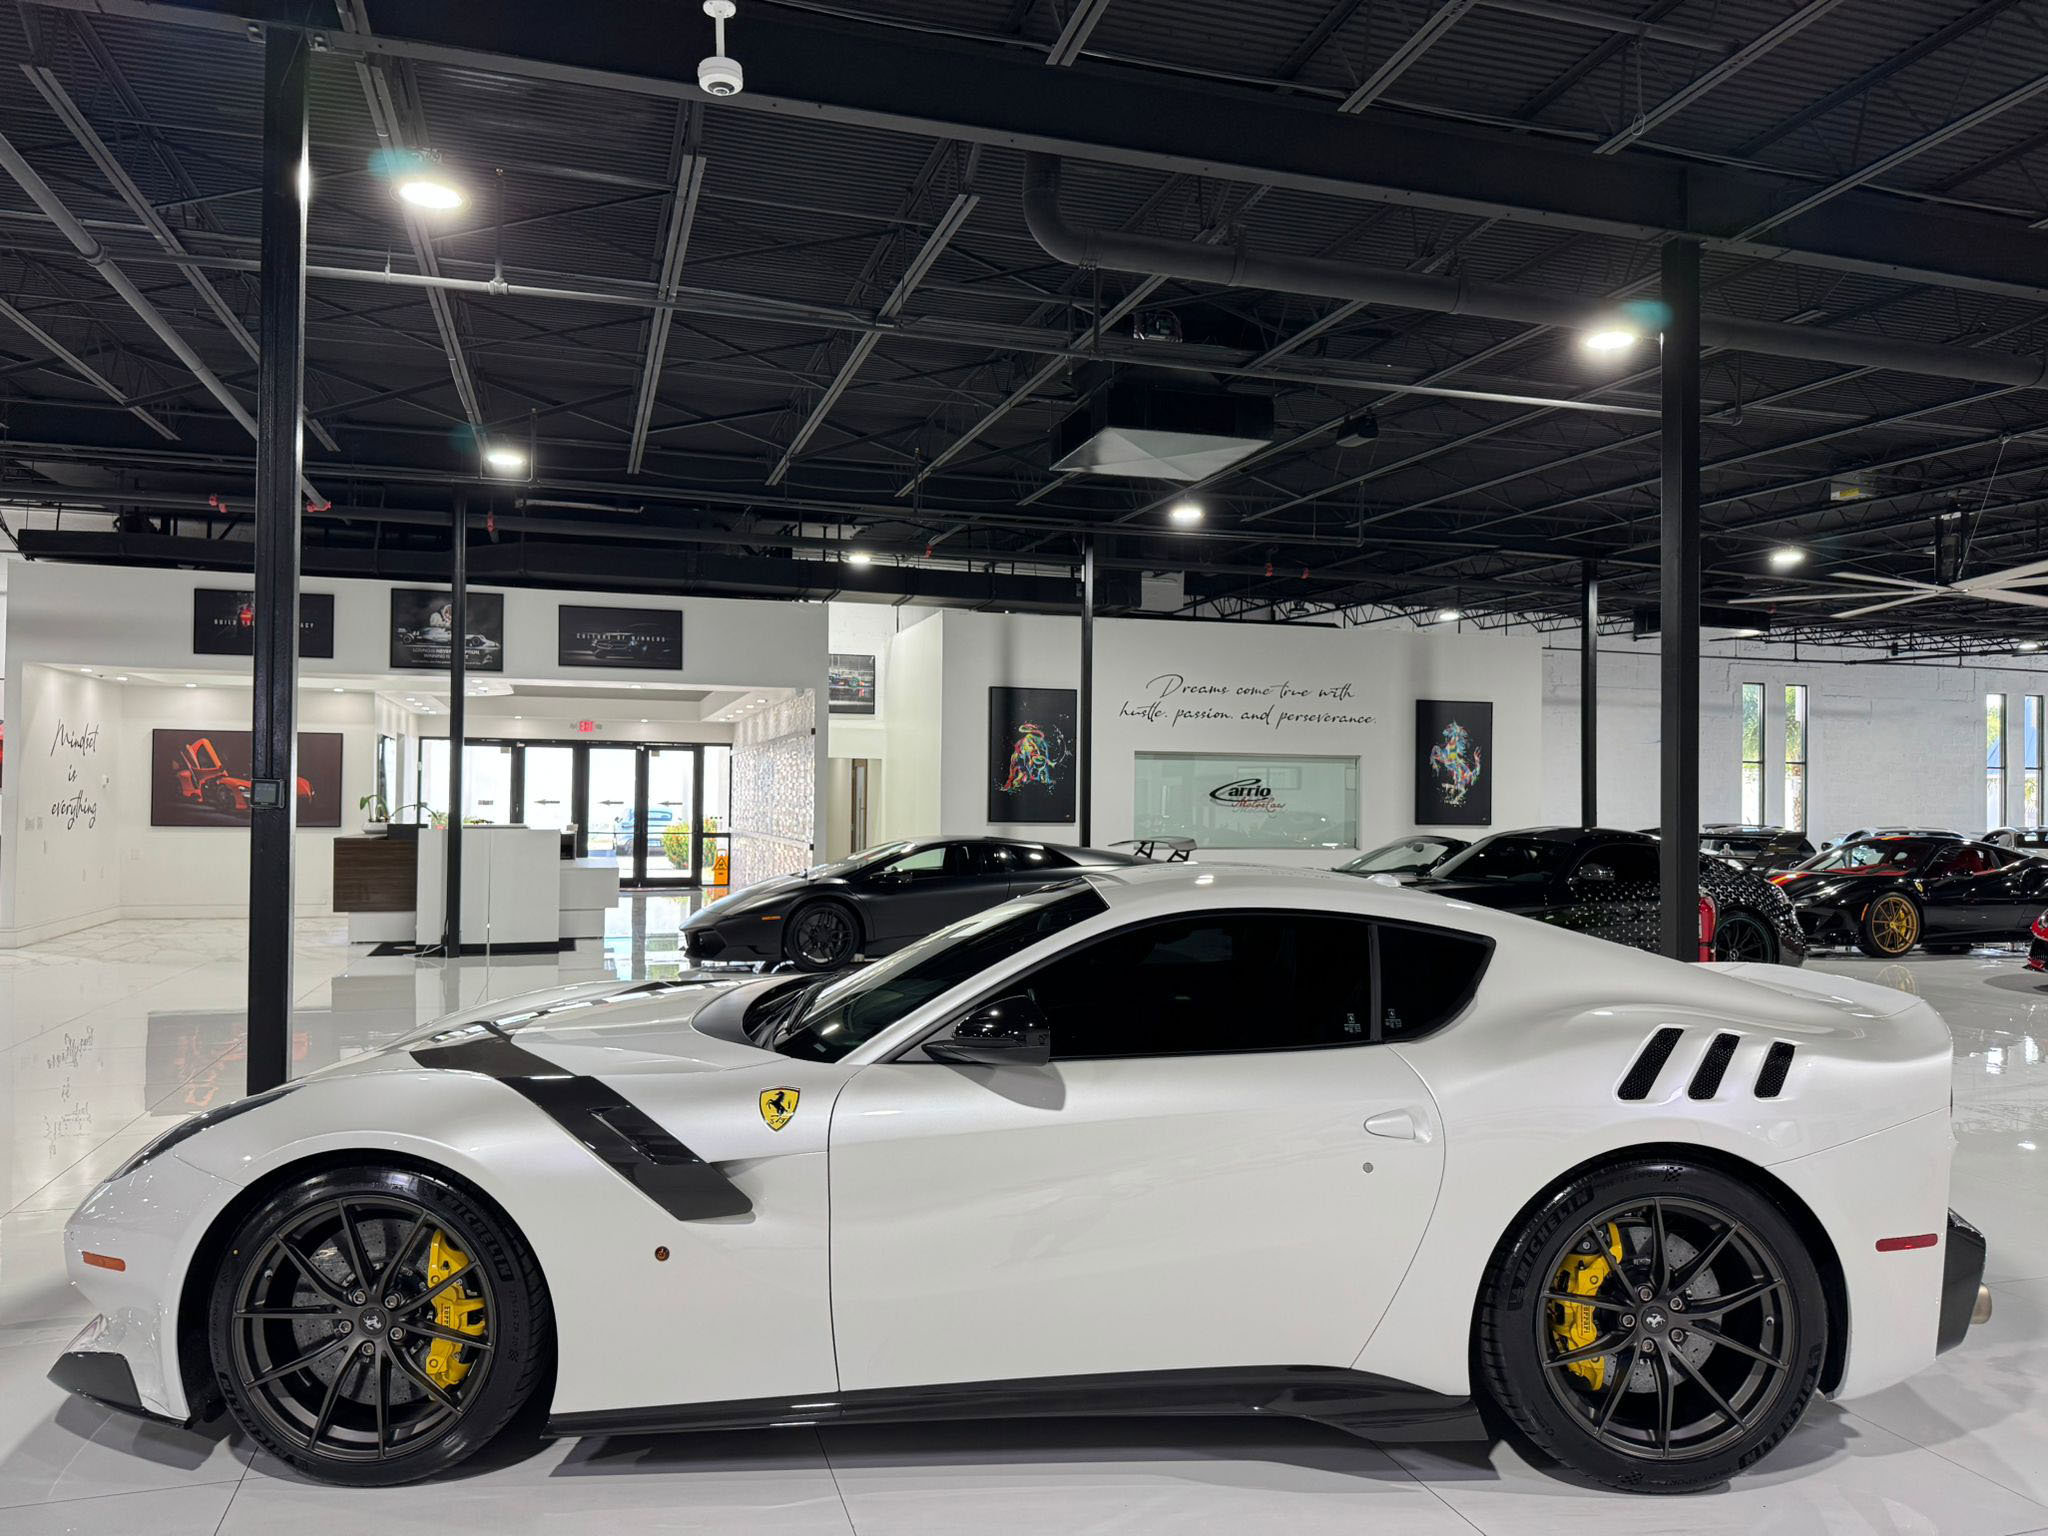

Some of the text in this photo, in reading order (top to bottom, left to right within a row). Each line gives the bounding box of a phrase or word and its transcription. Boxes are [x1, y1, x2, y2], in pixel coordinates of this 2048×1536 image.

[1146, 673, 1356, 701] Dreams come true with
[579, 721, 595, 732] EXIT
[1240, 704, 1276, 726] and
[50, 718, 99, 757] Mindset
[68, 764, 78, 782] is
[1209, 778, 1271, 802] Carrio
[51, 789, 97, 830] everything
[1516, 1186, 1593, 1285] MICHELIN
